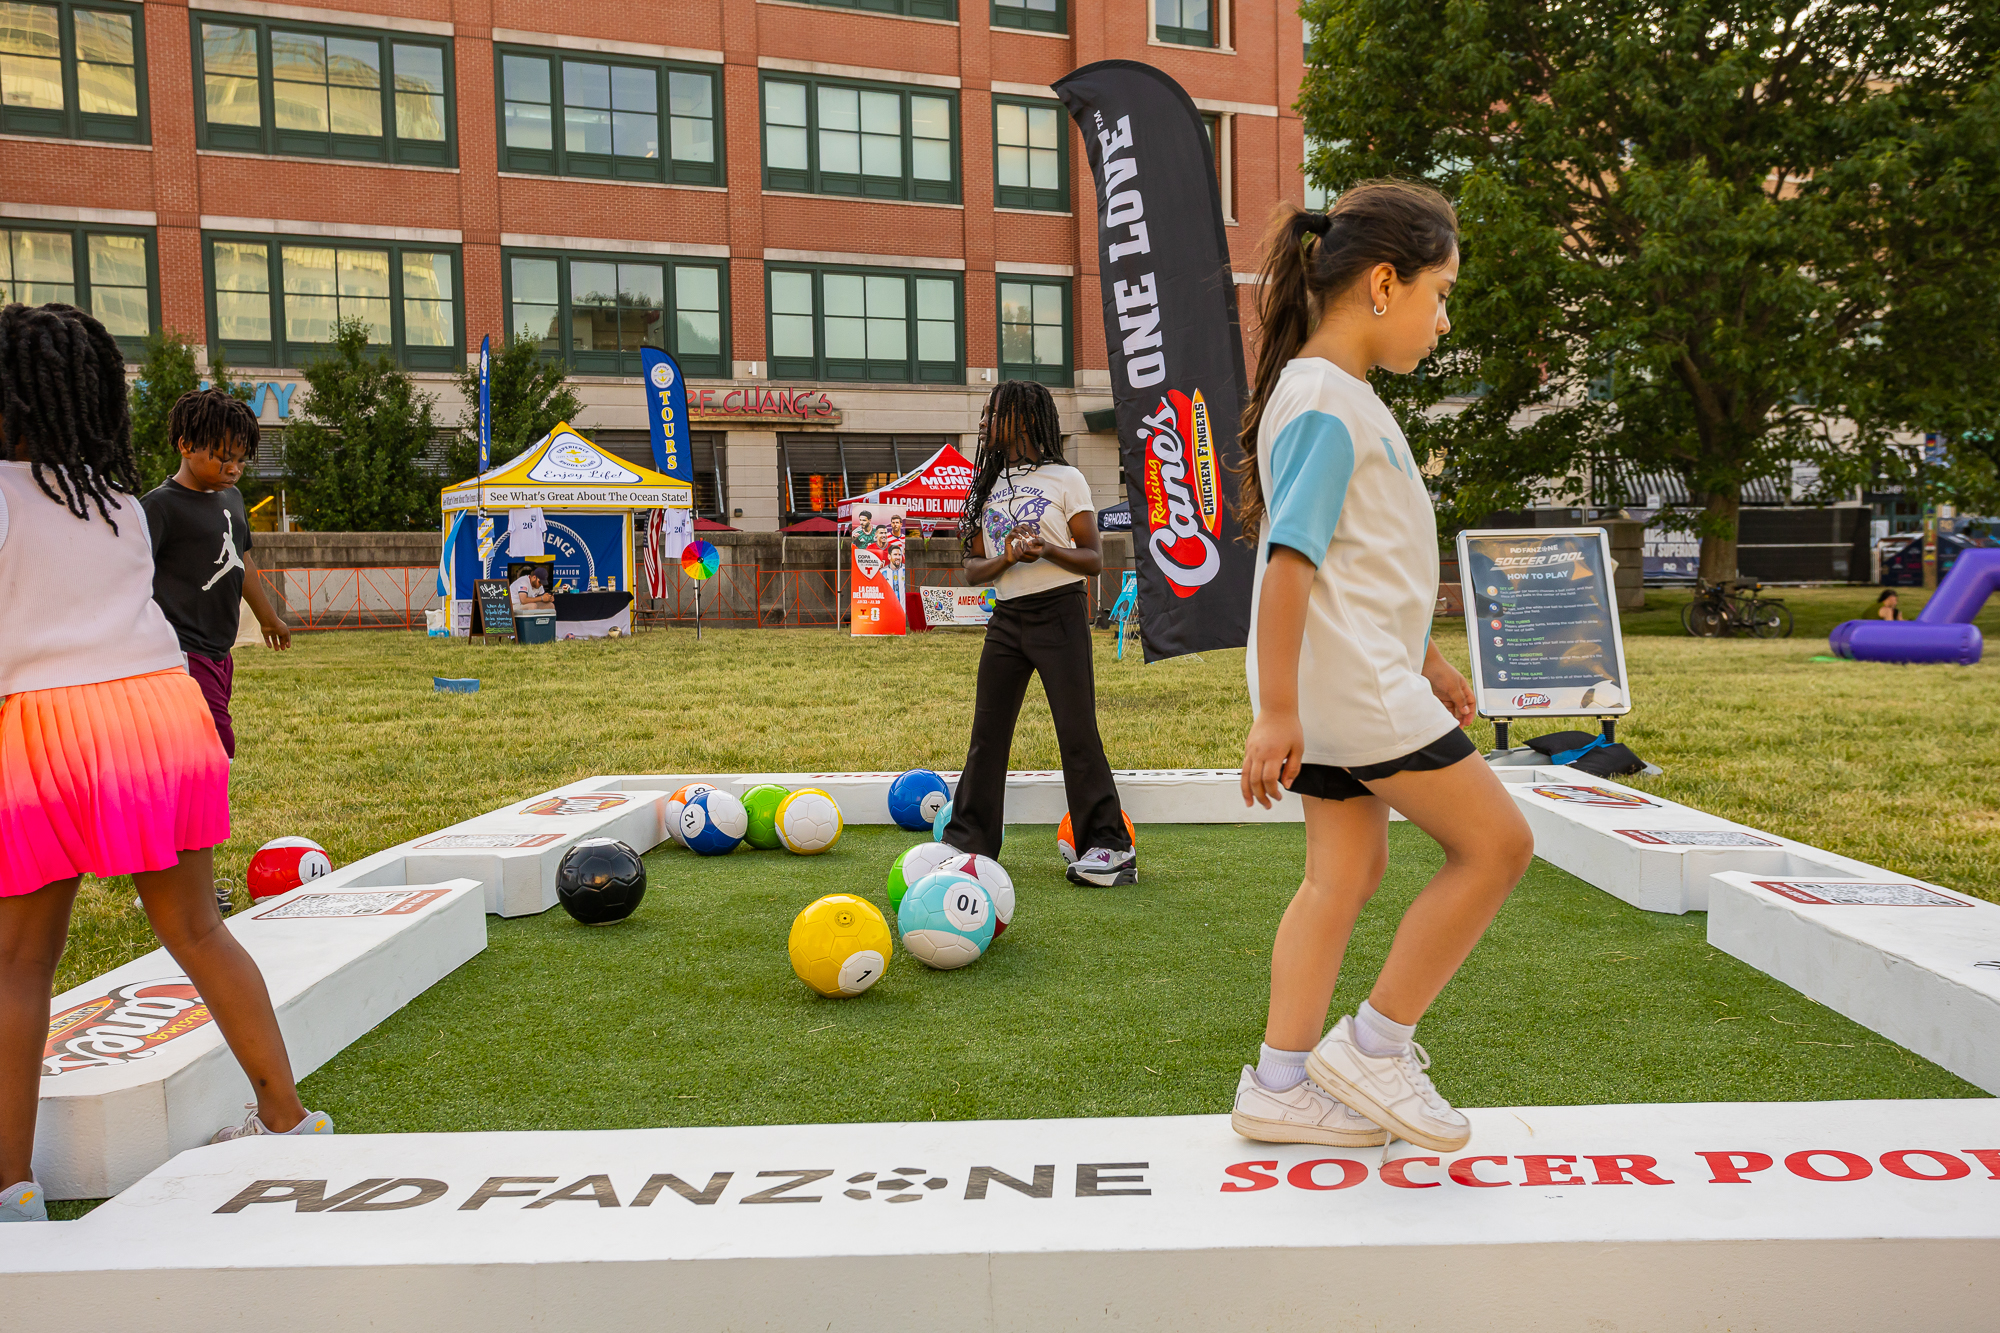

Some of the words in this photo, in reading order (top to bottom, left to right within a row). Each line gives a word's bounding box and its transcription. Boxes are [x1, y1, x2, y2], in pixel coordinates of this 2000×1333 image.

[1098, 114, 1151, 263] LOVE
[1113, 271, 1166, 389] ONE
[723, 386, 833, 419] CHANG'S
[659, 391, 677, 470] TOURS
[1194, 402, 1210, 457] FINGERS
[544, 470, 583, 480] Enjoy
[588, 470, 622, 480] Life!
[920, 476, 974, 486] MUND
[490, 491, 508, 502] See
[510, 491, 546, 502] What's
[547, 491, 574, 502] Great
[576, 491, 606, 502] About
[608, 491, 628, 502] The
[629, 492, 660, 502] Ocean
[661, 491, 688, 502] State!
[987, 485, 1020, 504] SWEET
[1021, 486, 1044, 498] GIRL
[1136, 396, 1220, 587] Cane's
[1146, 459, 1167, 525] Raising
[1199, 460, 1215, 516] CHICKEN
[926, 498, 942, 512] DEL
[922, 524, 934, 532] 26
[1494, 556, 1546, 566] SOCCER
[1547, 552, 1585, 564] POOL
[1546, 570, 1568, 580] PLAY
[958, 596, 986, 606] AMERICA
[1514, 692, 1550, 710] Cane's
[930, 802, 940, 813] 4
[684, 811, 696, 829] 12
[312, 863, 326, 878] 11
[957, 894, 979, 916] 10
[856, 969, 872, 983] 1
[146, 1004, 210, 1041] aising
[215, 1179, 449, 1214] PVD
[1222, 1156, 1674, 1193] SOCCER
